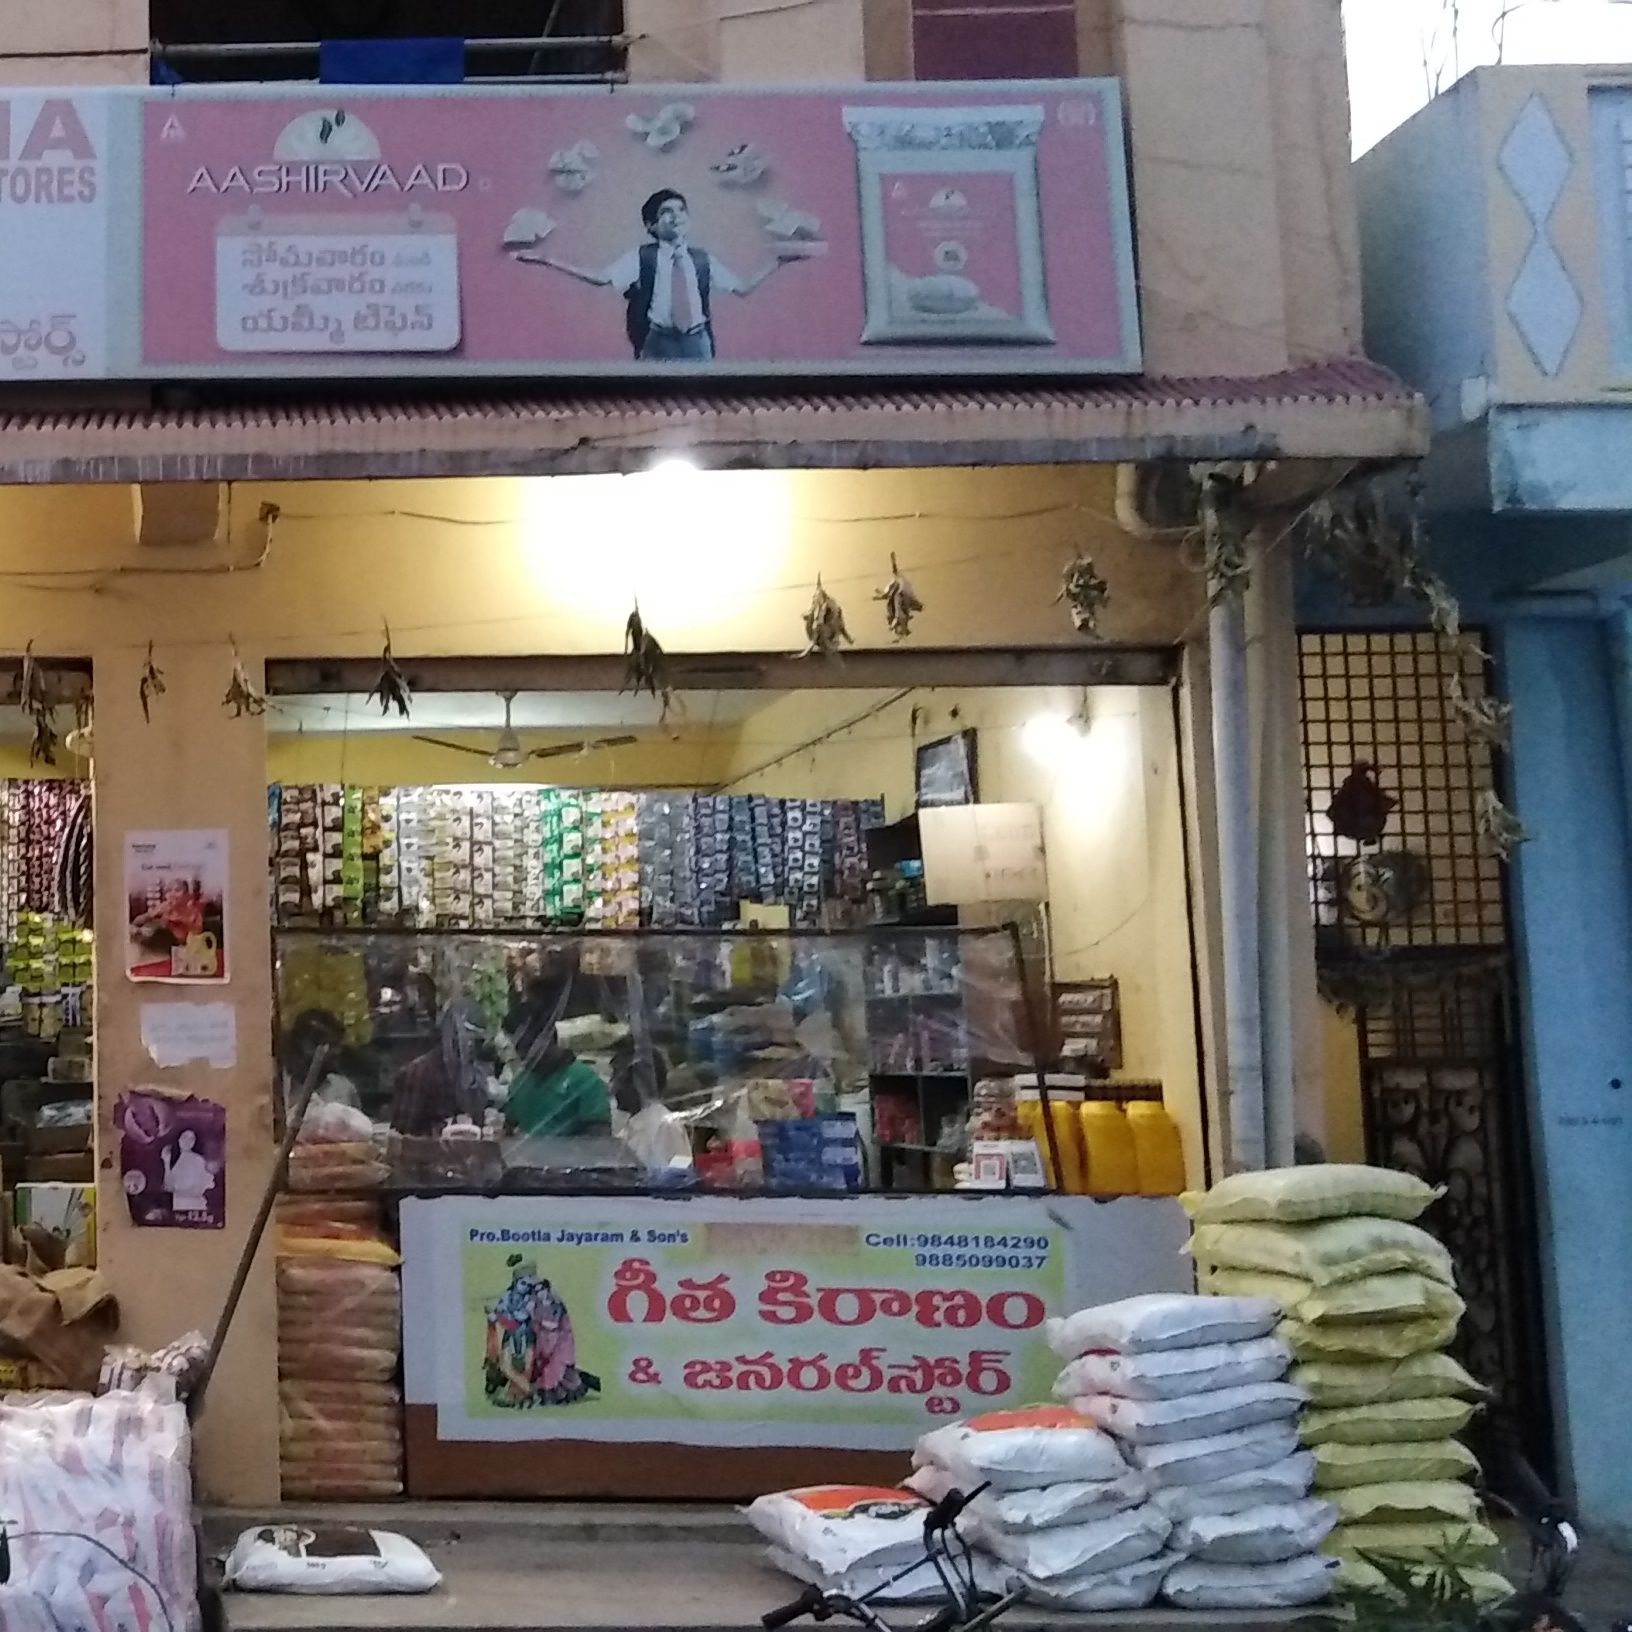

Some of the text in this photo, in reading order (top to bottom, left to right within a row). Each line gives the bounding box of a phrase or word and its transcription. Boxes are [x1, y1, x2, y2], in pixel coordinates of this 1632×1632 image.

[186, 162, 470, 198] AASHIRVAAD
[556, 1228, 624, 1246] Jayaram
[629, 1229, 642, 1243] &
[646, 1229, 689, 1244] Son's
[914, 1253, 1049, 1269] 9885099037
[606, 1256, 1047, 1330] గీత కిరాణం
[628, 1355, 662, 1385] &
